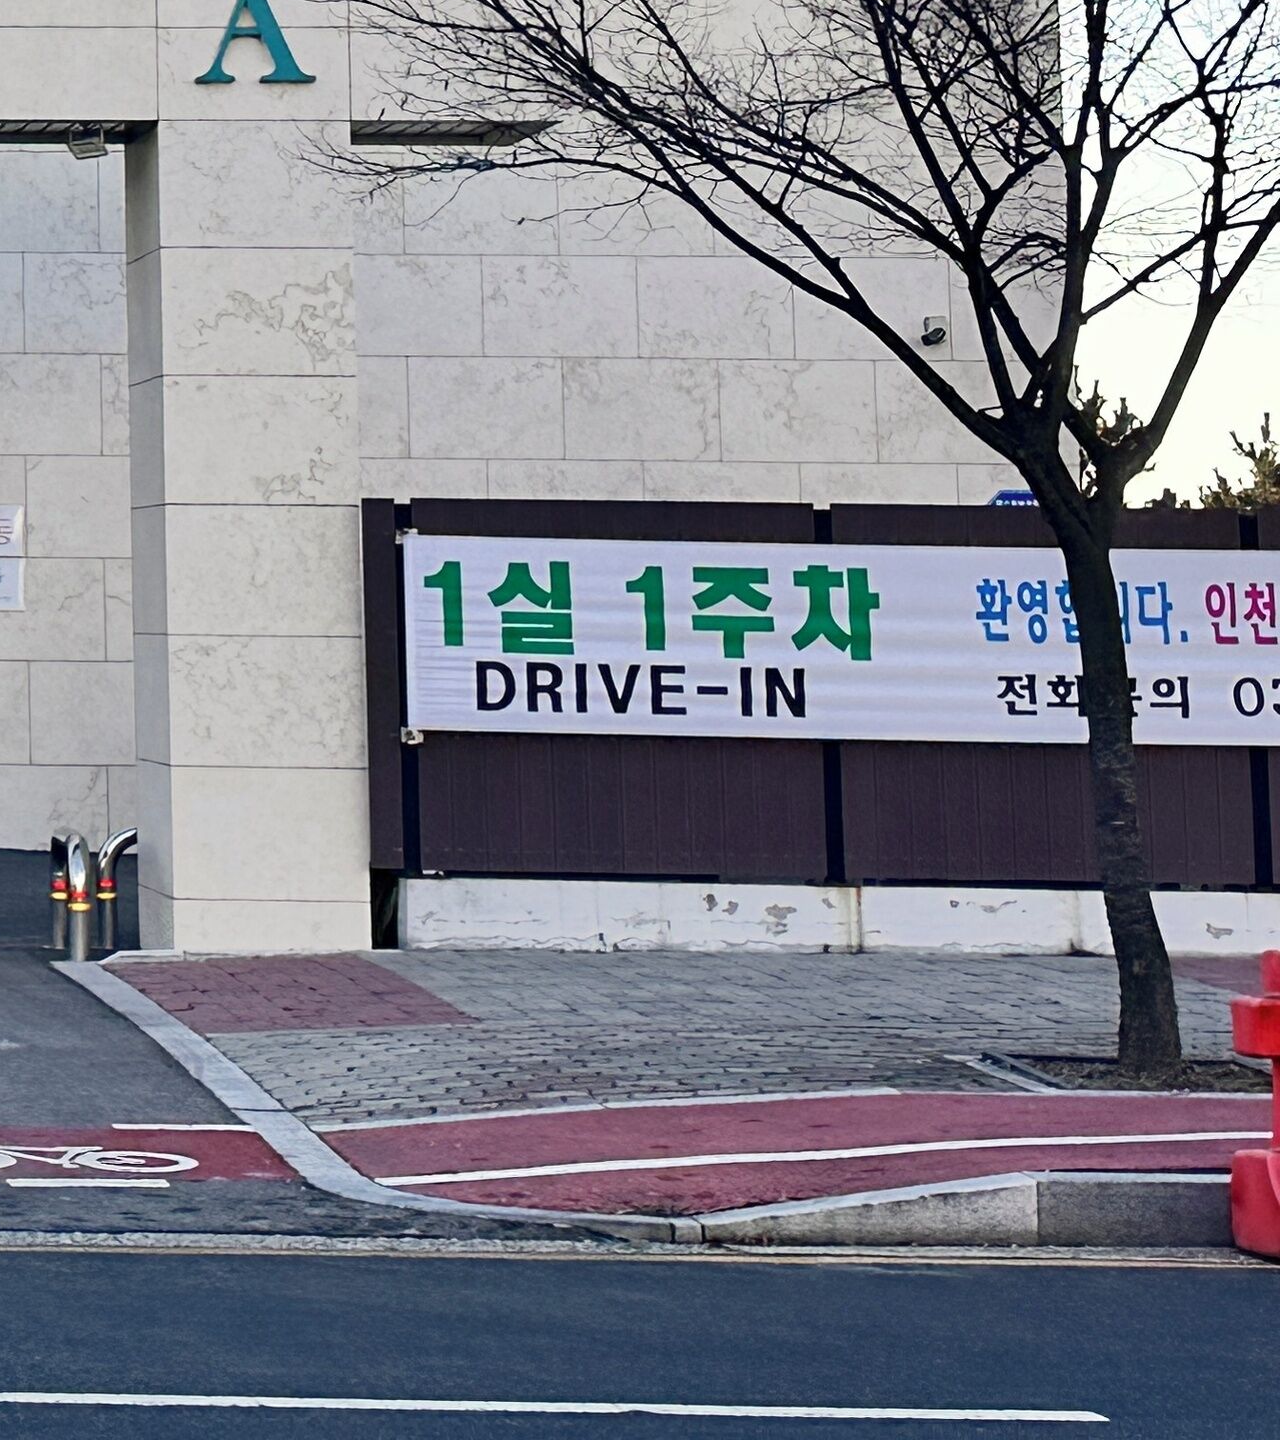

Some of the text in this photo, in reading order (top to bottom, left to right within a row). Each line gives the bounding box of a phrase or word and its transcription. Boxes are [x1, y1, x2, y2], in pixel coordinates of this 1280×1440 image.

[423, 560, 880, 661] 1실 1주차
[475, 661, 806, 718] DRIVE-IN
